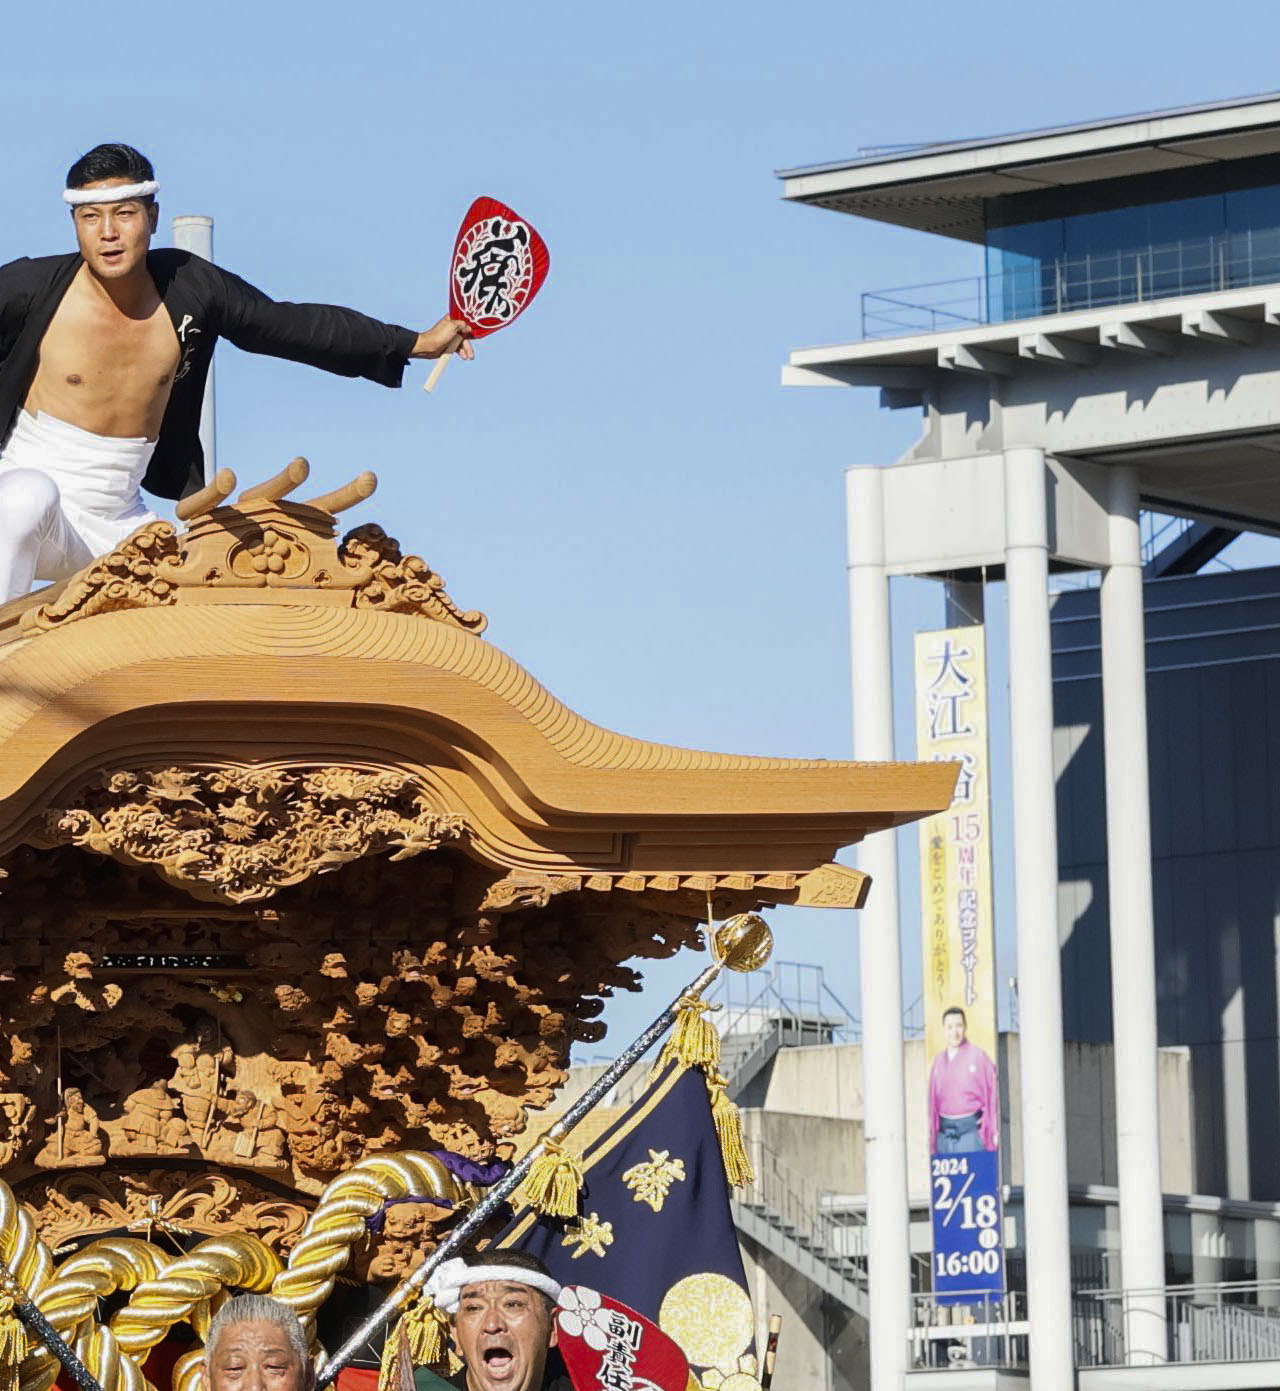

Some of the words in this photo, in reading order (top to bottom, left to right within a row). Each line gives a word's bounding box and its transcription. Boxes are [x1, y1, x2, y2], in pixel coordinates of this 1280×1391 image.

[932, 1158, 969, 1176] 2024
[933, 1173, 998, 1229] 2/18
[935, 1250, 1000, 1276] 16:00
